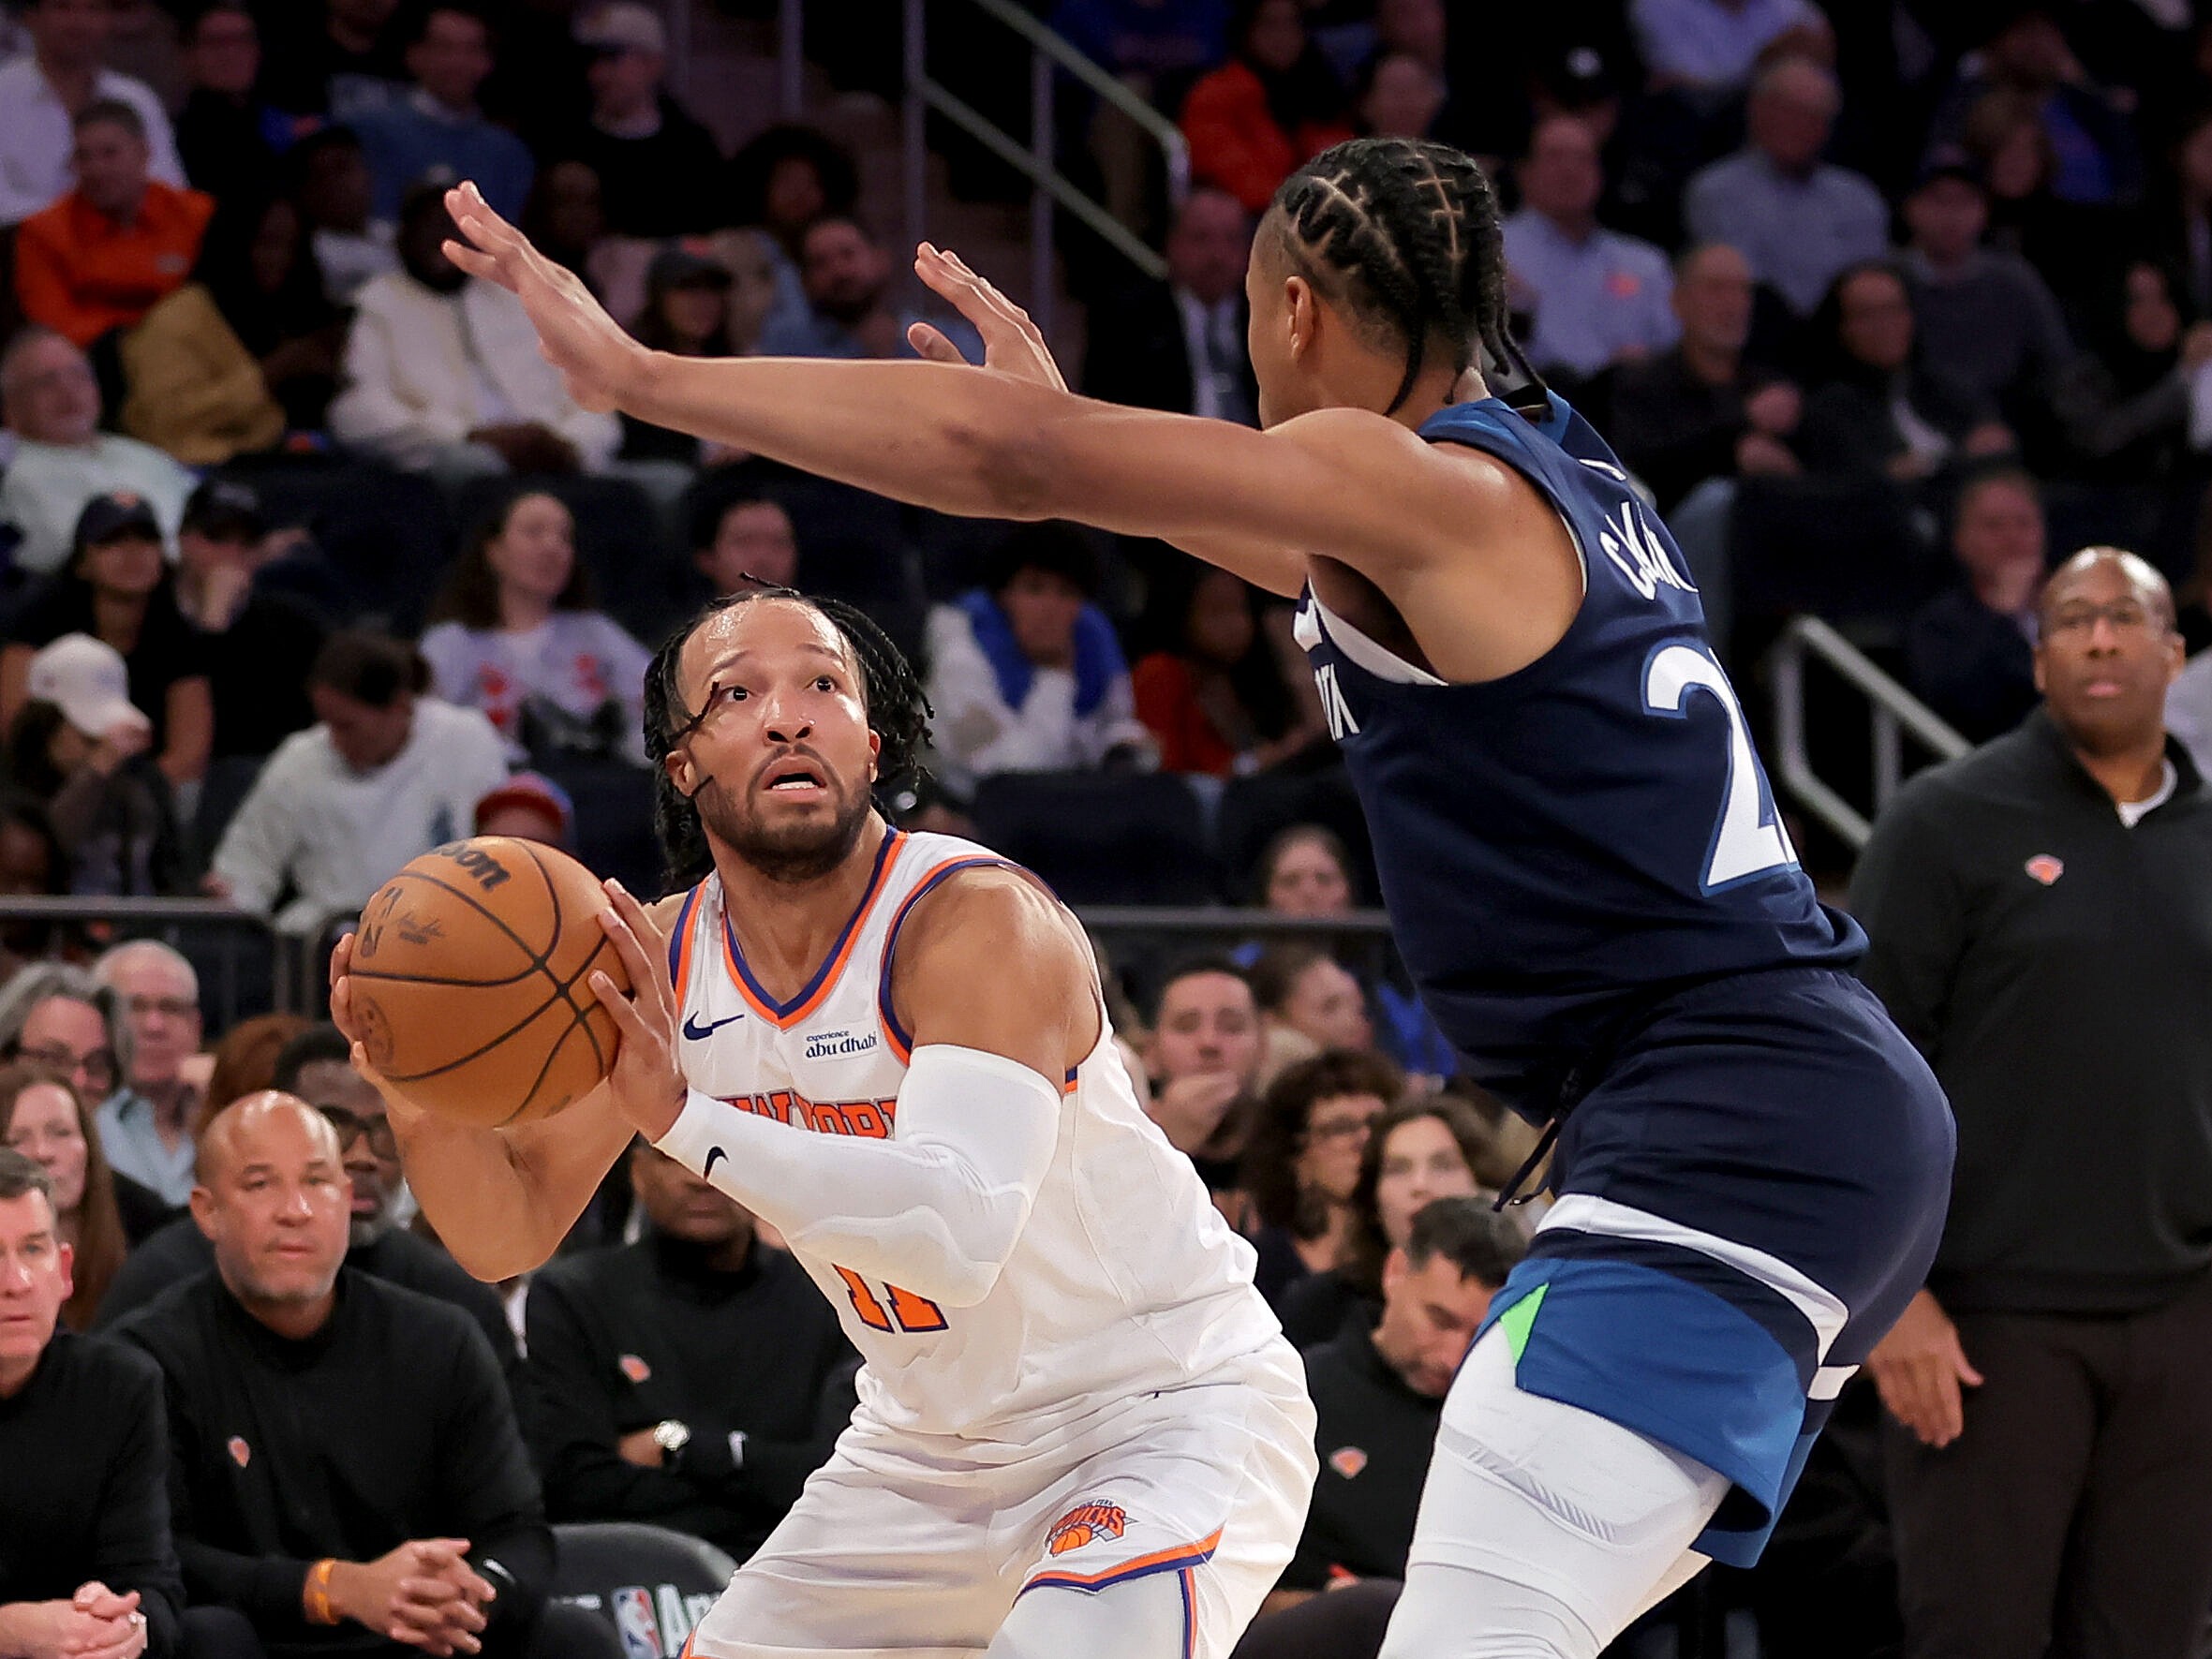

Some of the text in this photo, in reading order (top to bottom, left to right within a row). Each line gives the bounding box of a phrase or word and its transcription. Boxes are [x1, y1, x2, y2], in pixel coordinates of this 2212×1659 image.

[1641, 637, 1801, 897] 2
[806, 1030, 850, 1043] experience
[806, 1031, 878, 1059] abu dhabi
[1044, 1504, 1125, 1548] ICKS
